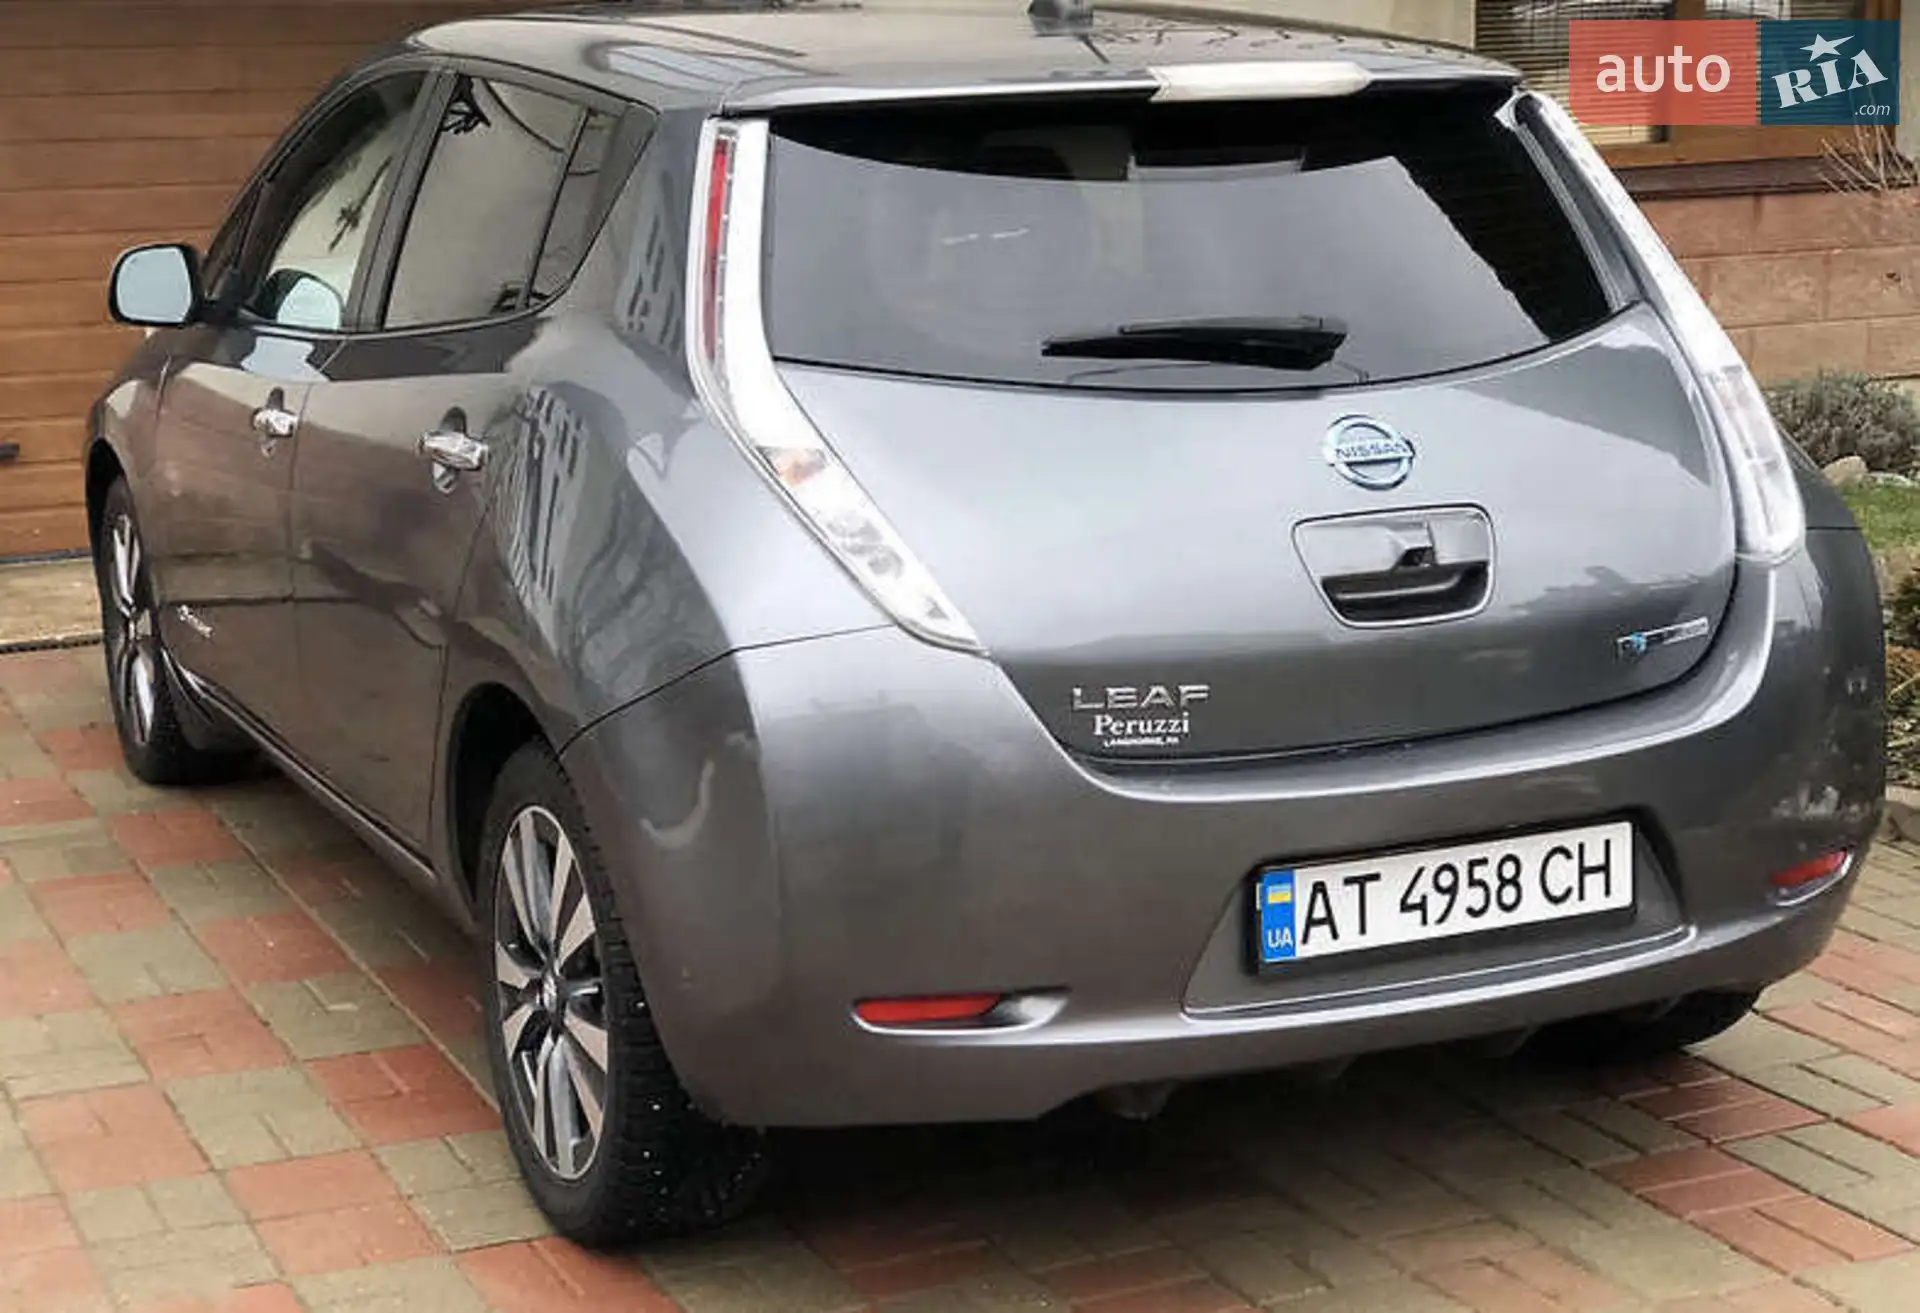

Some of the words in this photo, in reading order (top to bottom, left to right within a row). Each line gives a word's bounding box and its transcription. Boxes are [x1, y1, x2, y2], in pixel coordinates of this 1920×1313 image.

[1072, 684, 1210, 711] LEAF
[1093, 711, 1190, 736] Peruzzi
[1301, 873, 1381, 945] AT
[1399, 853, 1522, 926] 4958
[1539, 838, 1612, 906] CH
[1266, 927, 1294, 948] UA
